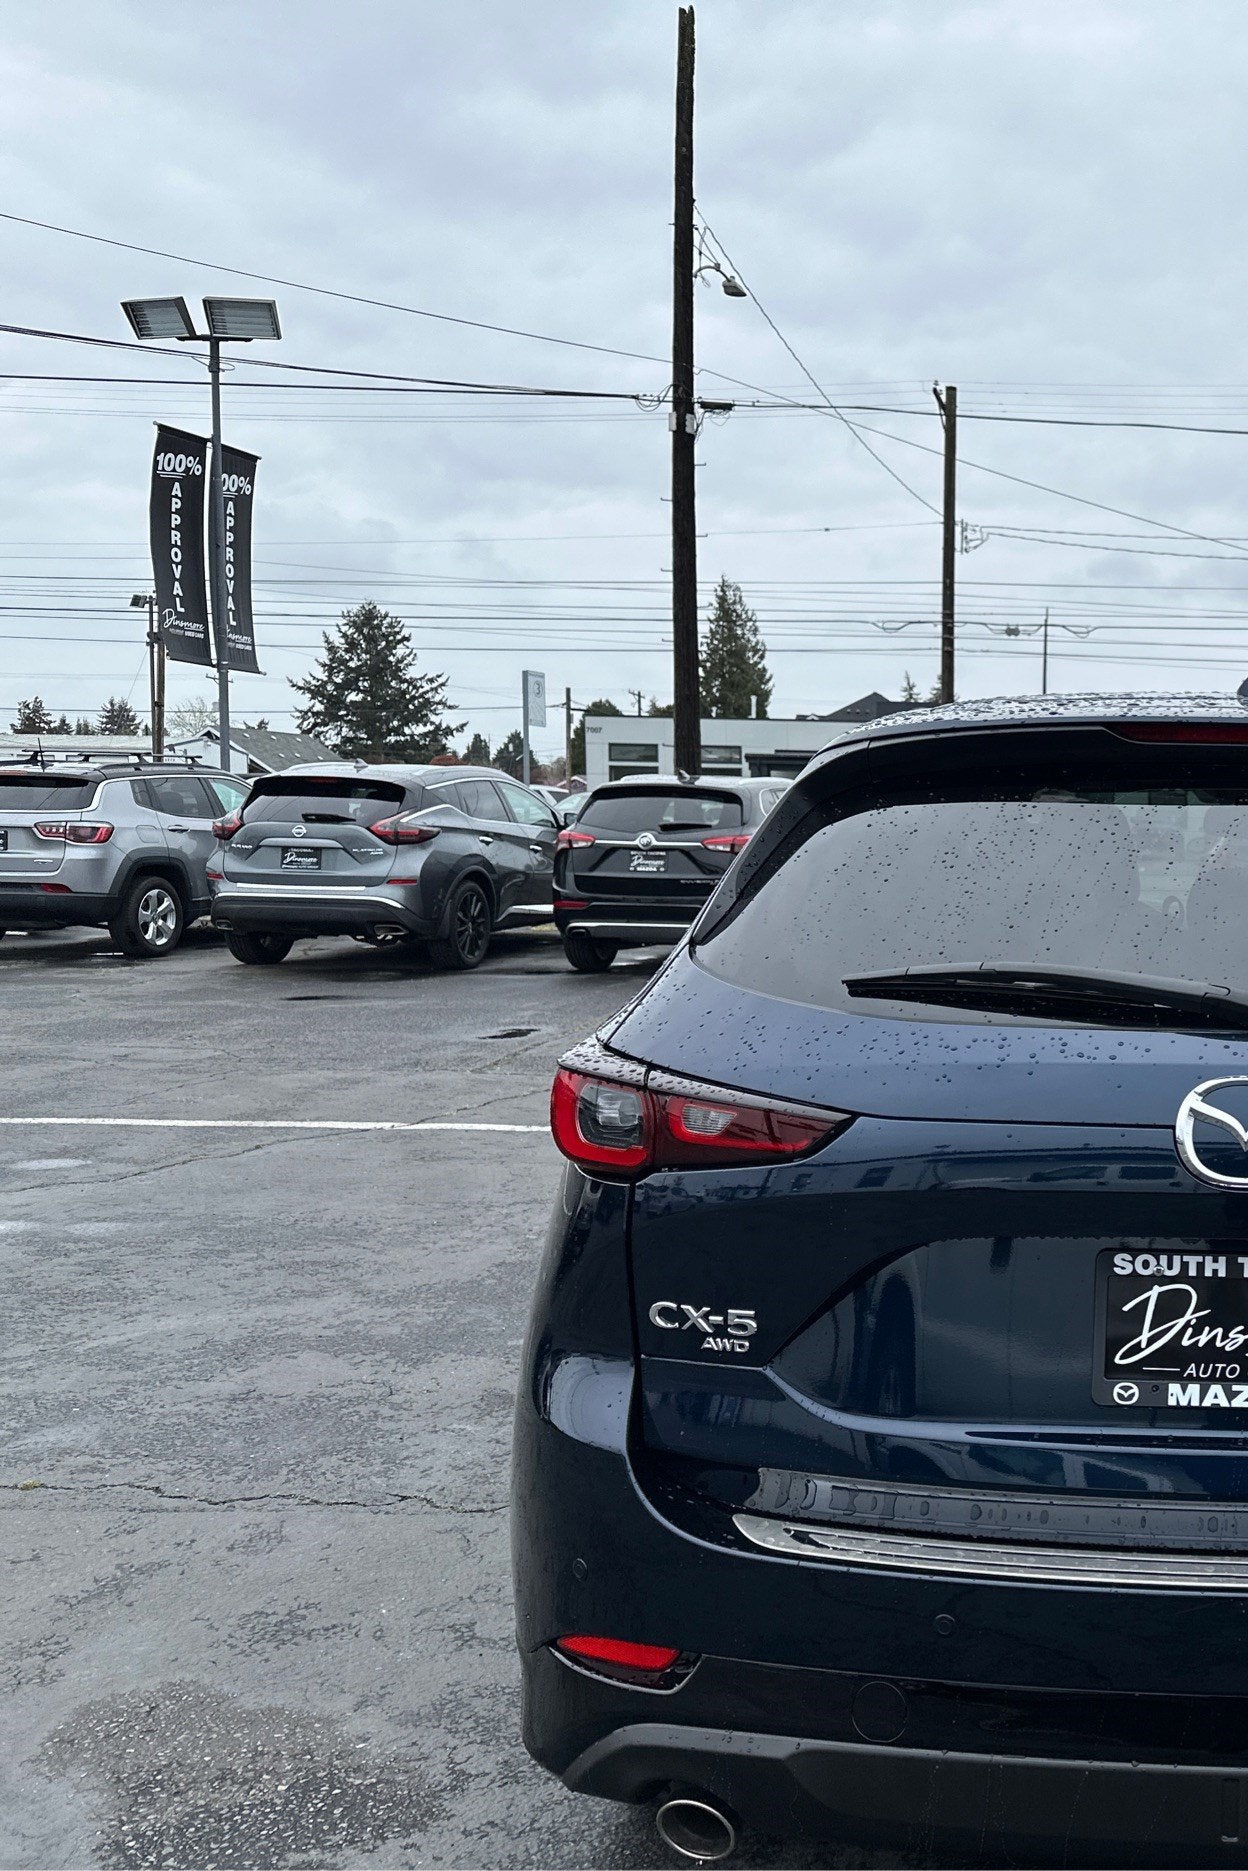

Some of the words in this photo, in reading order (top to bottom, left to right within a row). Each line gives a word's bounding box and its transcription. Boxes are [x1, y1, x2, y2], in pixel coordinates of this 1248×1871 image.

[157, 452, 202, 476] 100%
[221, 473, 252, 495] 00%
[170, 481, 185, 613] APPROVAL
[225, 501, 236, 626] APPROVAL
[162, 608, 205, 631] Dinsmore
[1113, 1253, 1227, 1278] SOUTH
[649, 1301, 757, 1337] CX-5
[700, 1336, 750, 1353] AWD
[1183, 1363, 1241, 1379] AUTO
